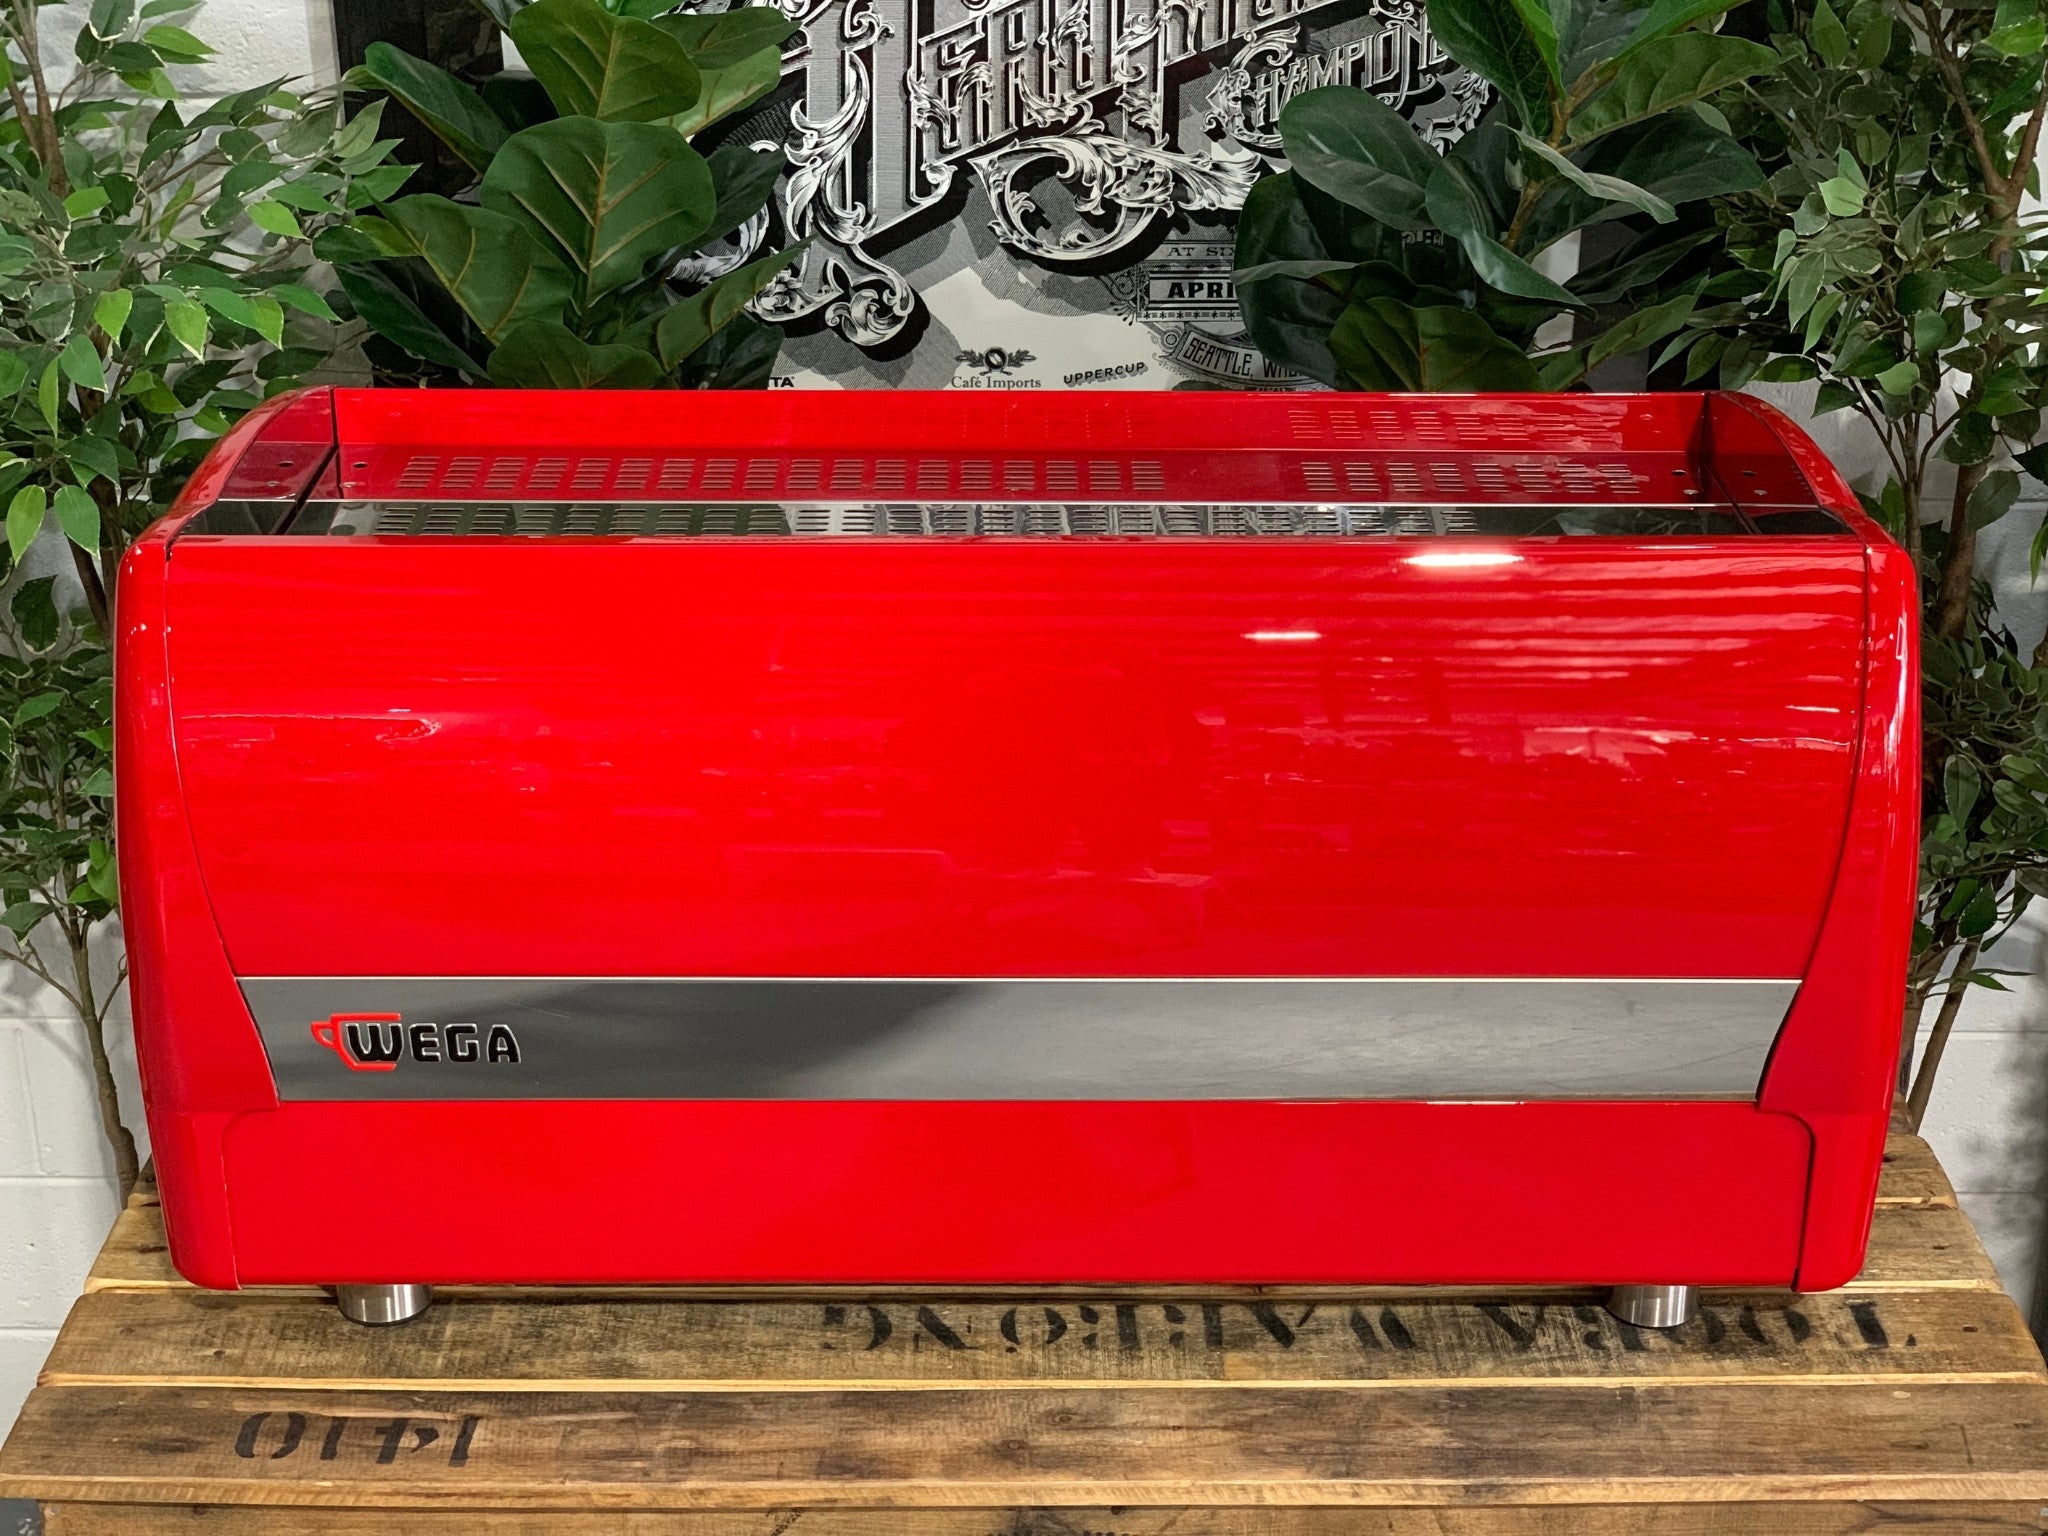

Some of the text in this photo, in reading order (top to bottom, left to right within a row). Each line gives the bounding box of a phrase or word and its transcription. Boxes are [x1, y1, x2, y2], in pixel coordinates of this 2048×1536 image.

[1206, 14, 1449, 148] CHAMPION
[1168, 247, 1196, 257] AT
[1167, 282, 1235, 299] APRI
[1063, 361, 1147, 386] UPPERCUP
[1182, 337, 1254, 378] SEATTLE,
[951, 376, 1042, 391] Café Imports
[345, 1023, 521, 1064] WEGA
[234, 1411, 483, 1467] 1410
